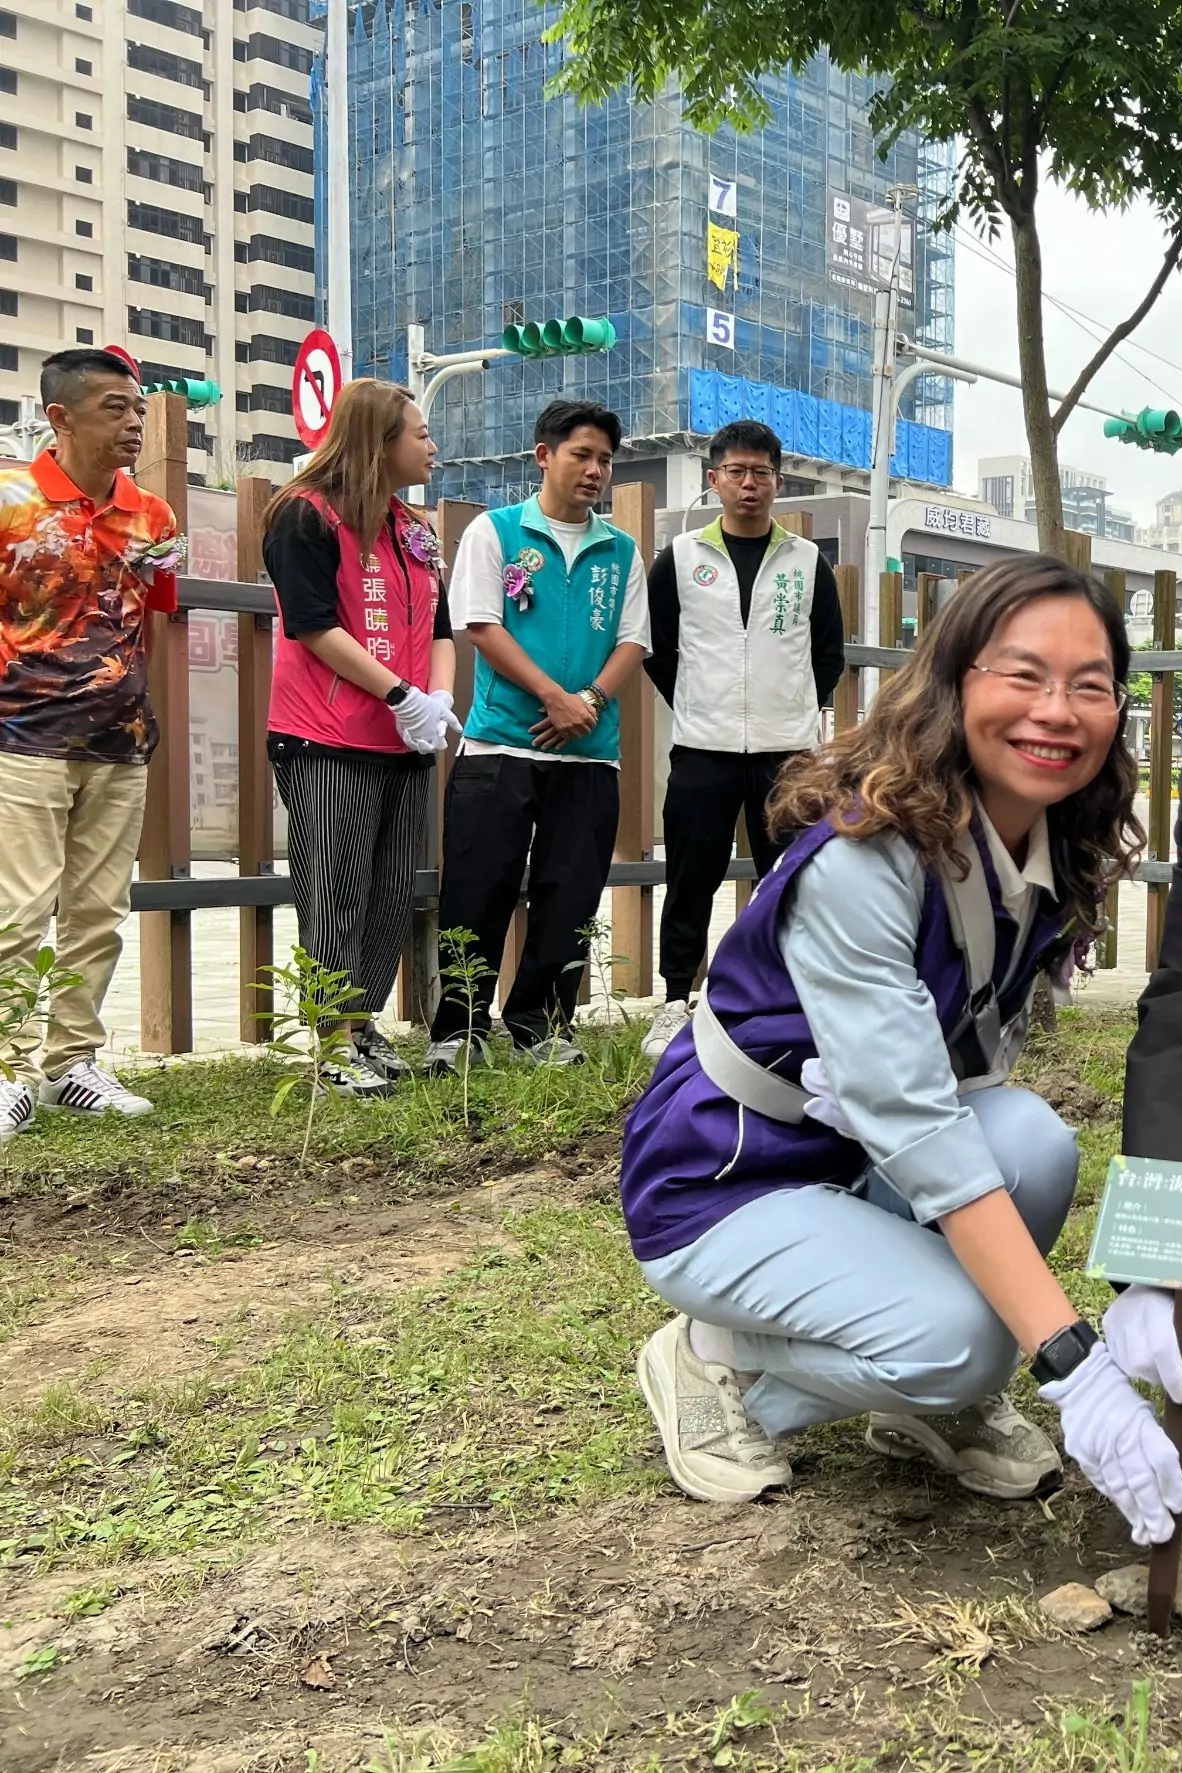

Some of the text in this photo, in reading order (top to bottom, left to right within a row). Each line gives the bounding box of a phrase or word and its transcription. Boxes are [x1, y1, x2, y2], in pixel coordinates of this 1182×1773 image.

[713, 178, 731, 210] 7
[713, 311, 730, 343] 5
[925, 507, 990, 537] 威均君藏
[362, 578, 391, 660] 張曉昀
[588, 564, 609, 631] 彭俊豪
[769, 573, 791, 635] 黃崇真
